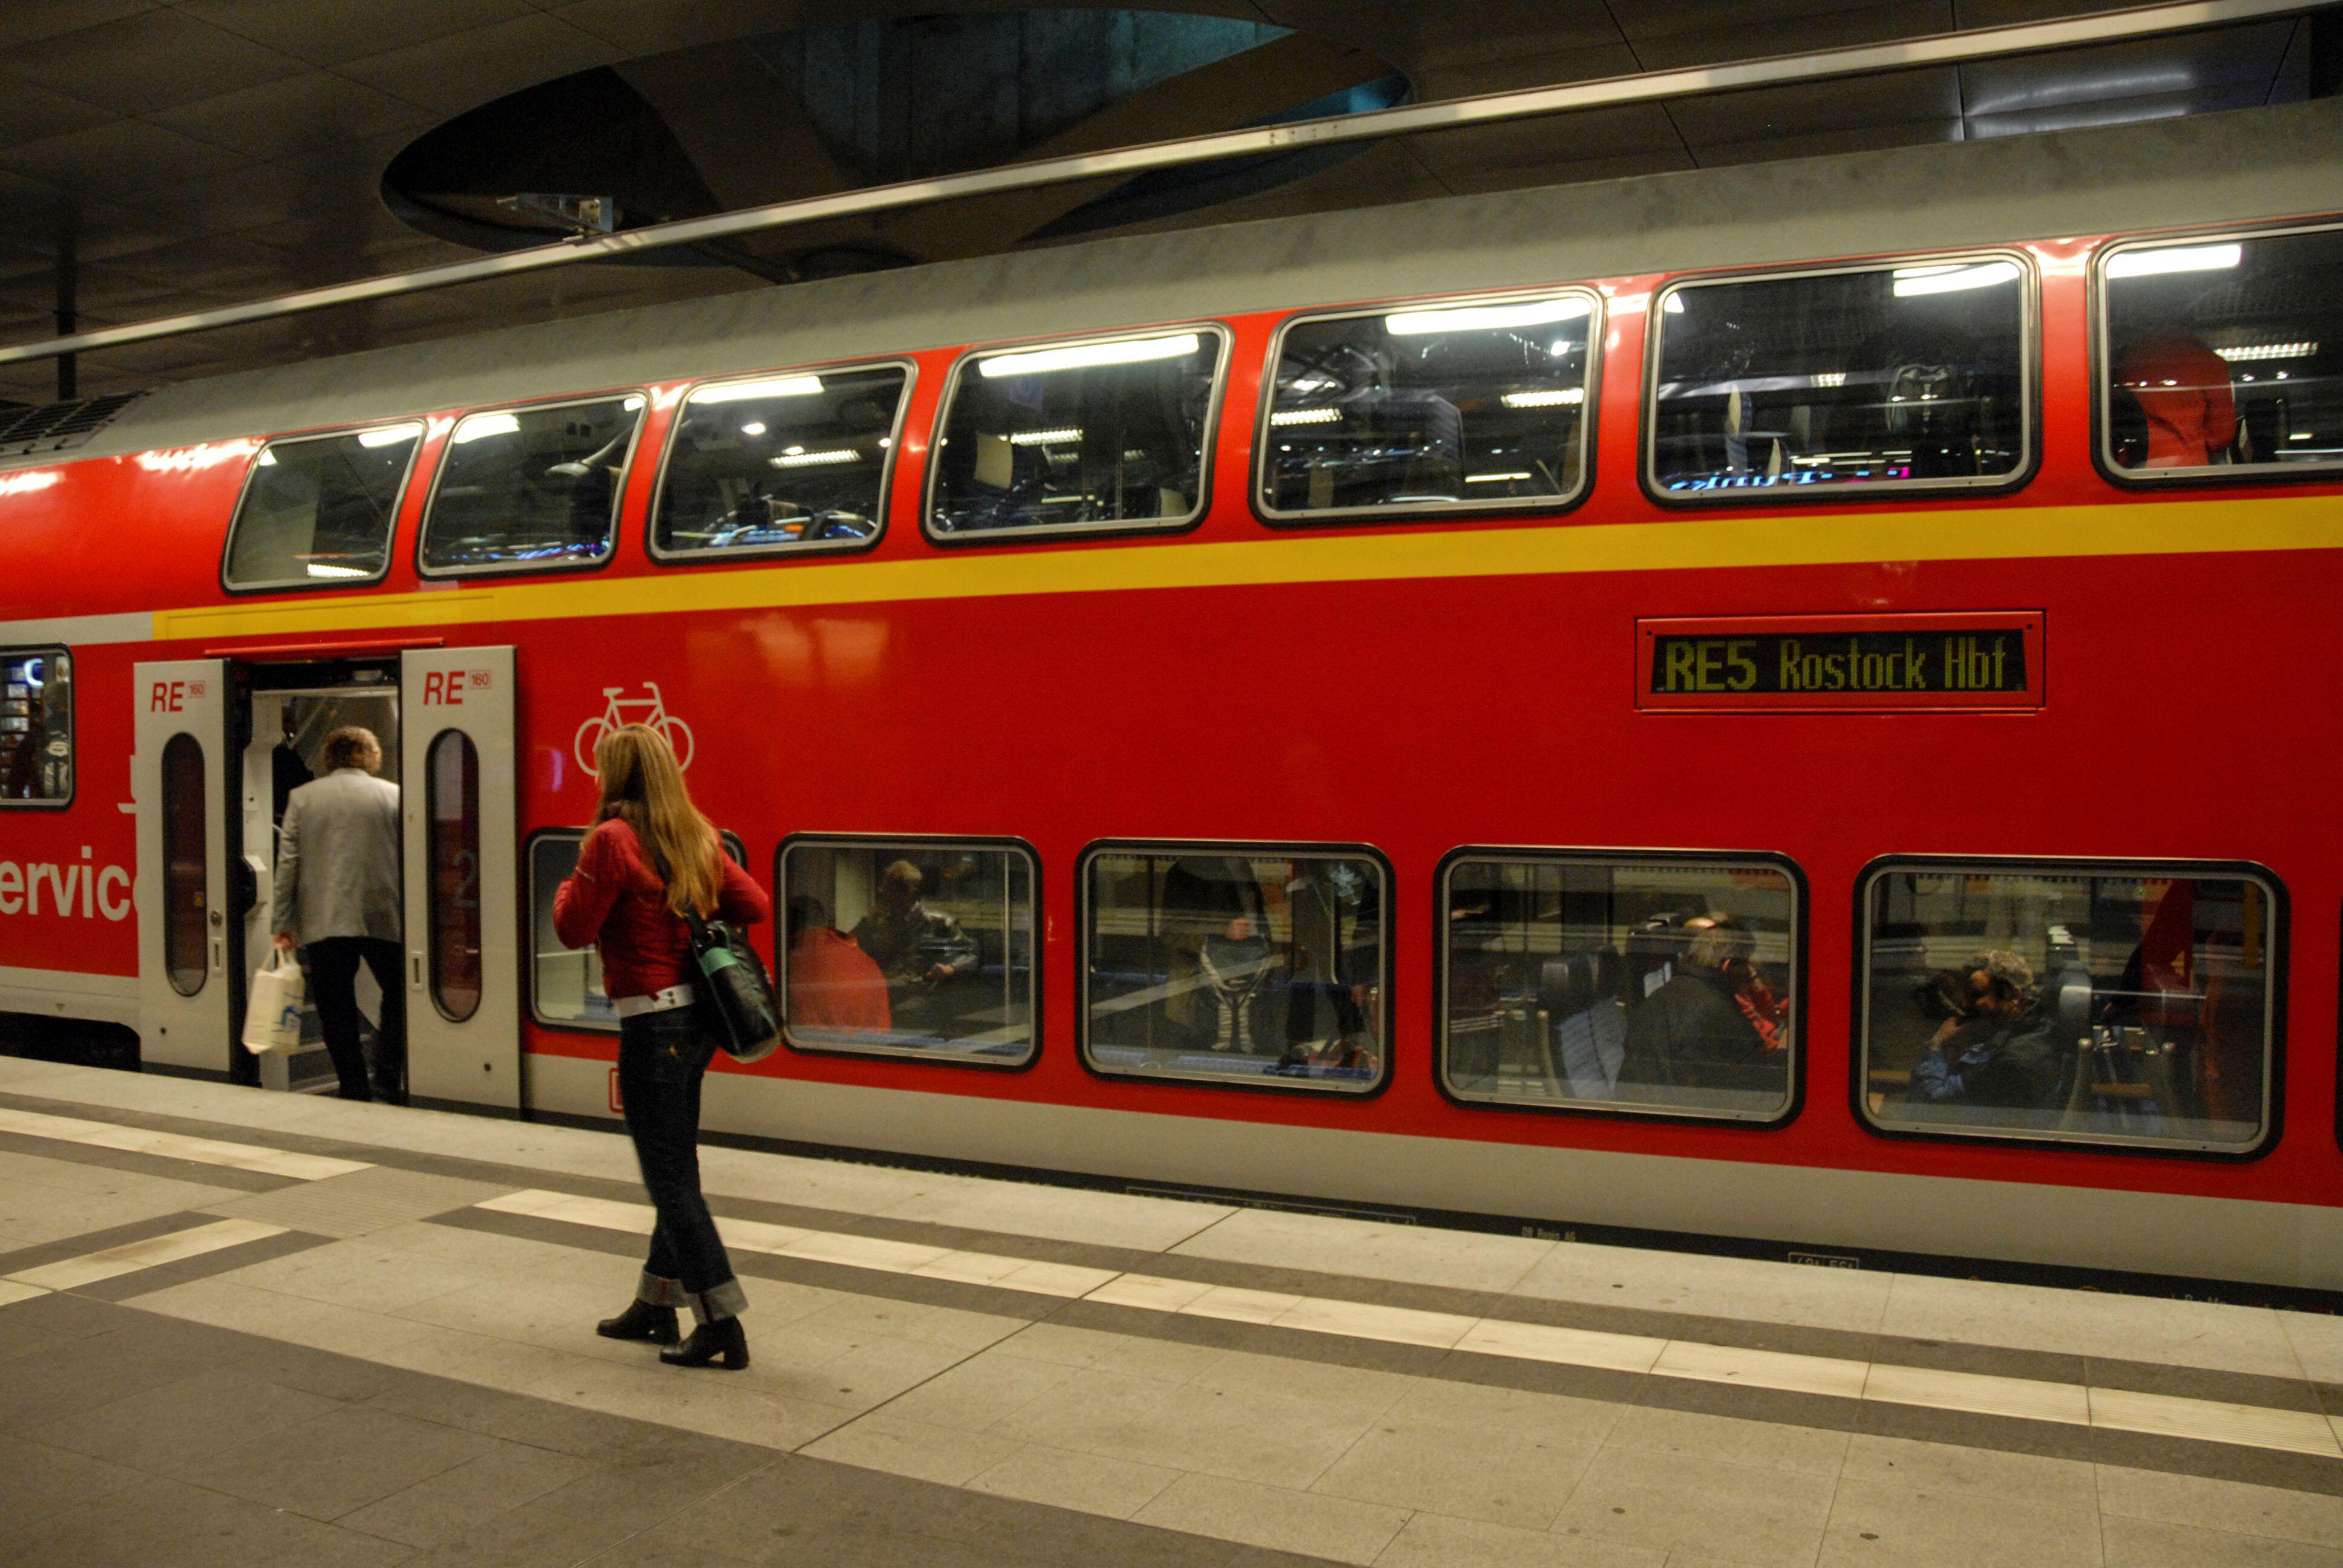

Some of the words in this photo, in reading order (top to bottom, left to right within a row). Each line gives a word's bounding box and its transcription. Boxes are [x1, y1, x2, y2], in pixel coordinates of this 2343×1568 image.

[1666, 641, 1756, 691] RE5
[1780, 639, 1926, 690] Rostock
[1944, 636, 2007, 688] Hbf
[151, 681, 185, 712] RE
[423, 670, 466, 705] RE
[471, 672, 489, 685] 160
[0, 846, 138, 921] ervic
